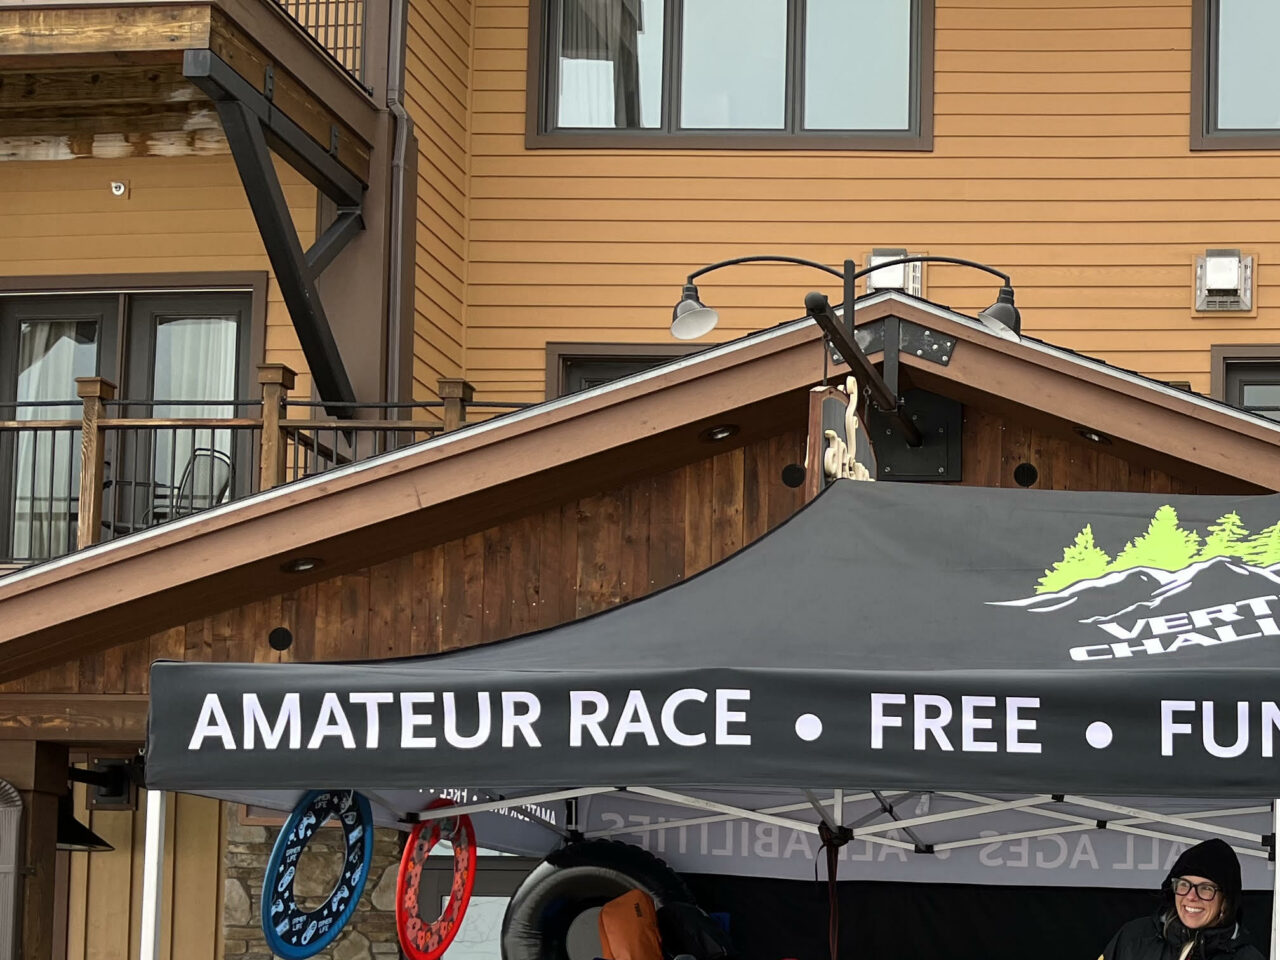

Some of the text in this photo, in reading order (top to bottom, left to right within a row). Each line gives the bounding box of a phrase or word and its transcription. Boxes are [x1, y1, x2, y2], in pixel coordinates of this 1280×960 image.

[188, 689, 542, 750] AMATEUR
[569, 687, 752, 747] RACE
[870, 692, 1042, 754] FREE
